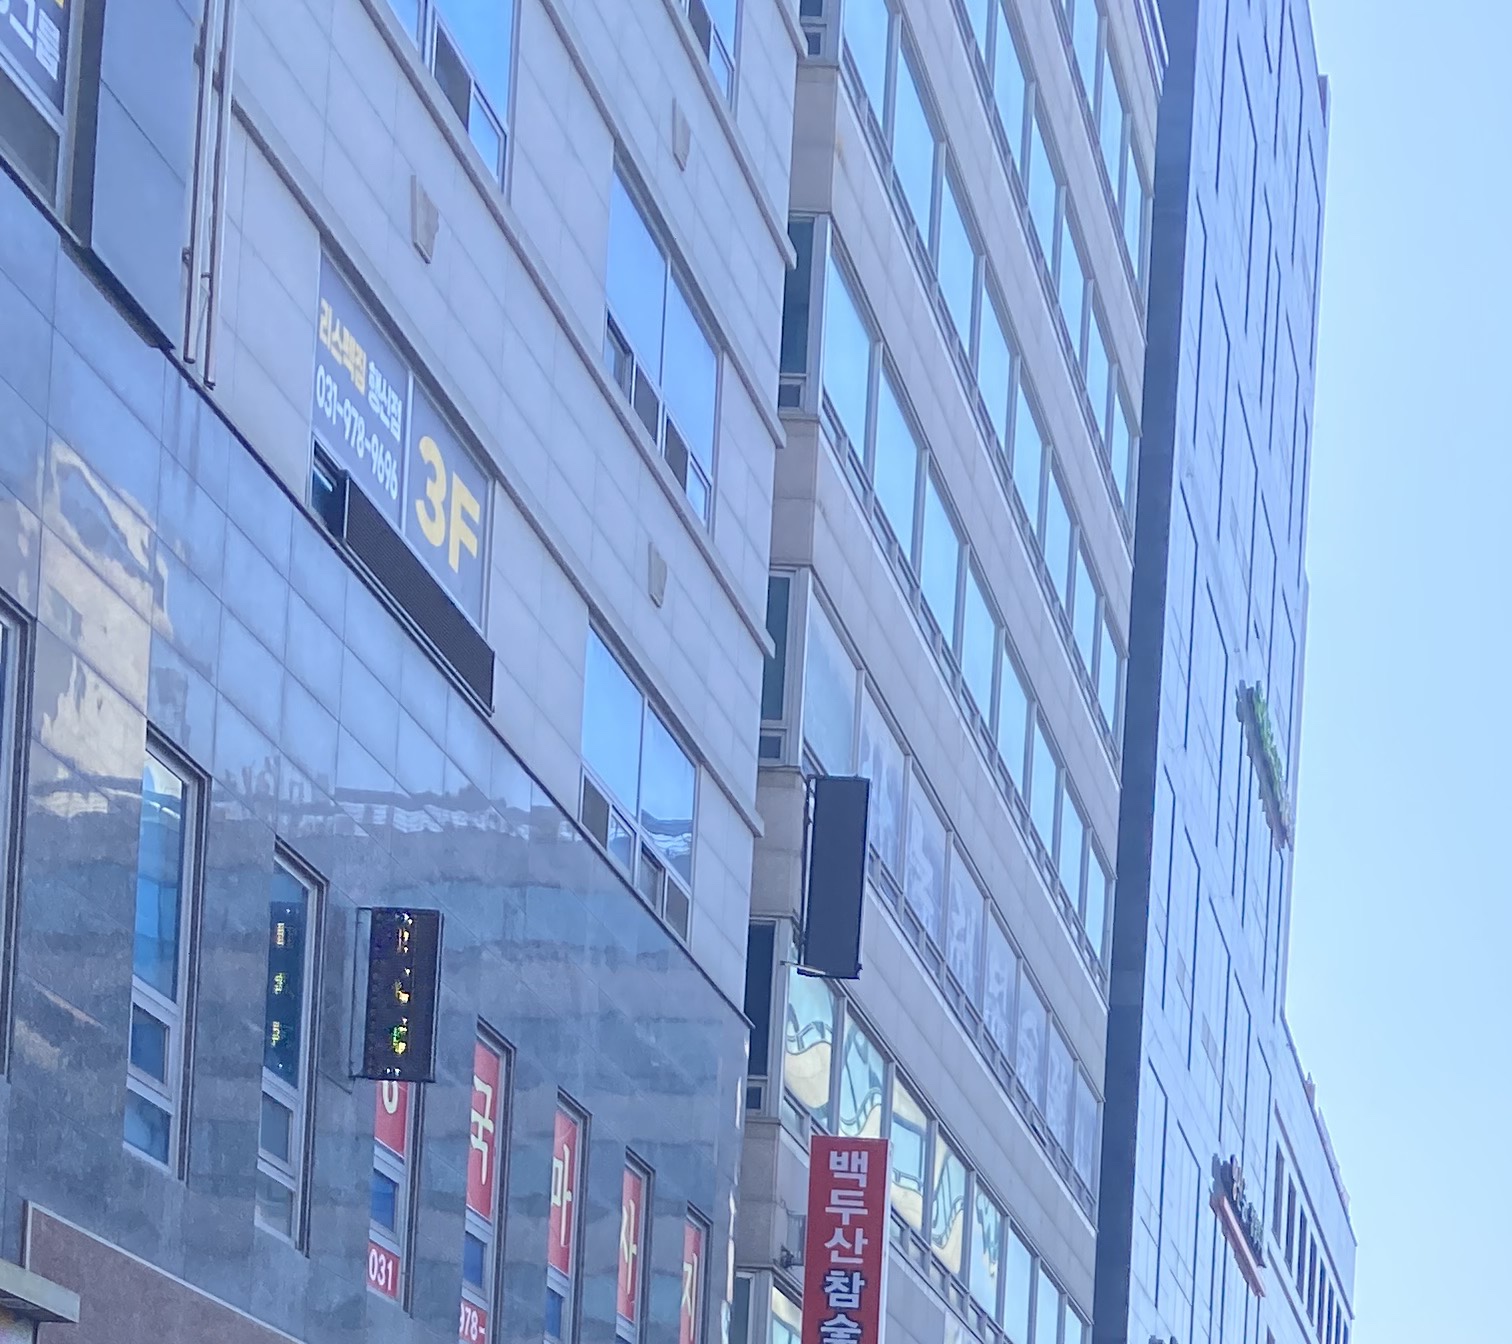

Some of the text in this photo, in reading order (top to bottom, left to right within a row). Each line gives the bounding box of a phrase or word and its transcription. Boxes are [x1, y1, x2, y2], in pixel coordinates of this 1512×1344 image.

[316, 363, 398, 500] 031-978-9696
[415, 436, 481, 573] 3F
[368, 1249, 393, 1292] 031
